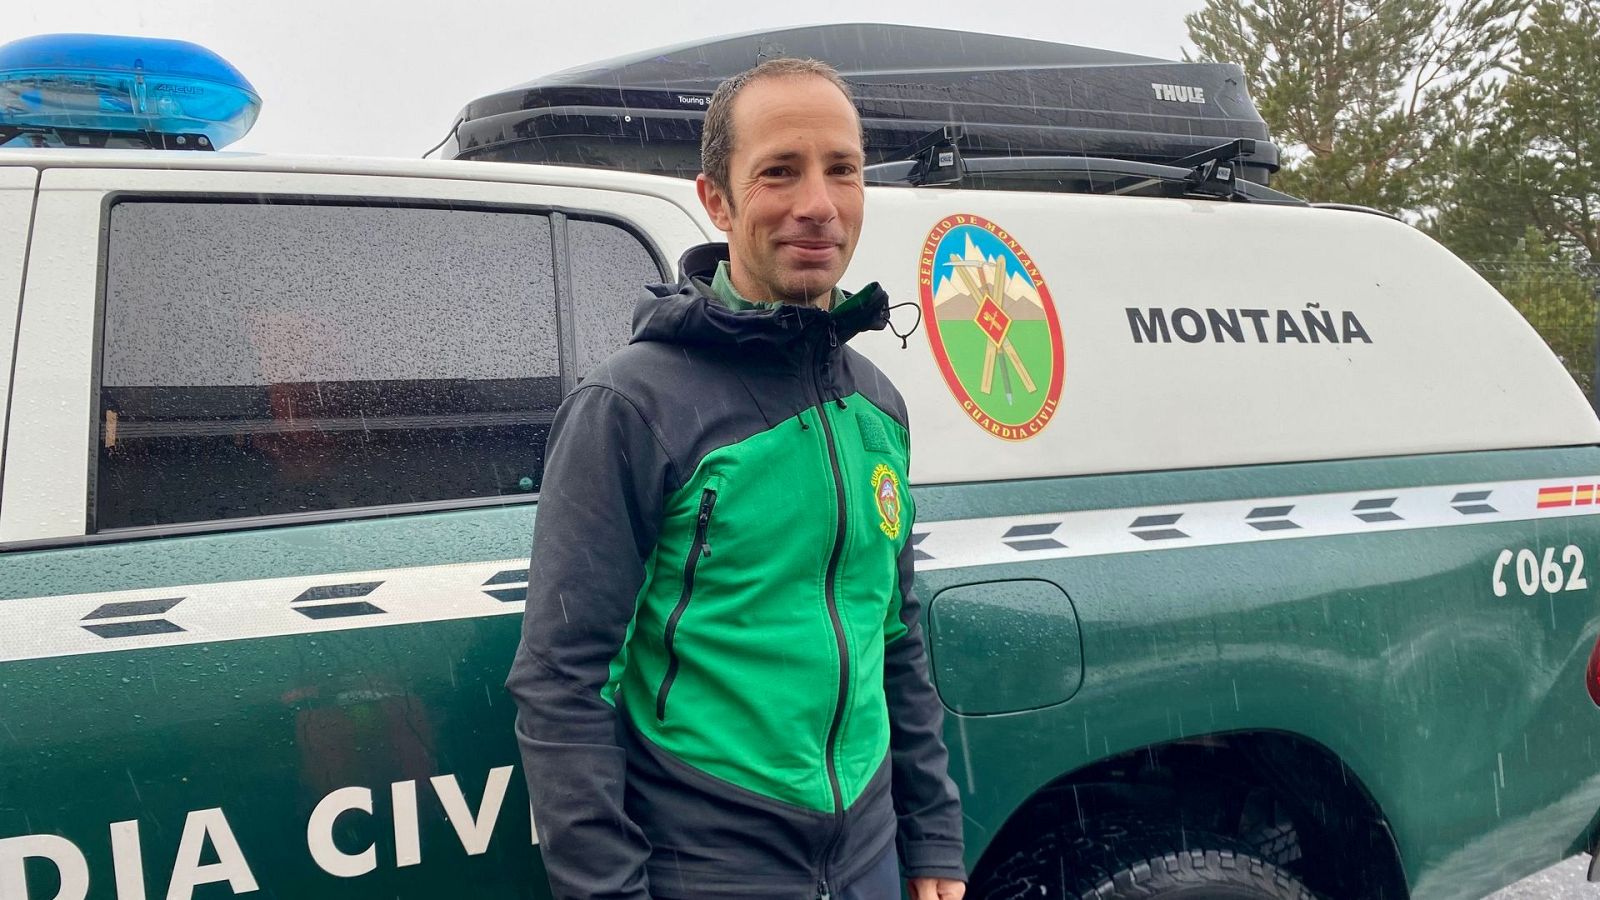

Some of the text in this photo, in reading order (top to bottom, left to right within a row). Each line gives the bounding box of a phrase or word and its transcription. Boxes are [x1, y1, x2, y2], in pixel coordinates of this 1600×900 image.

[678, 96, 704, 105] Touring
[1151, 83, 1206, 104] THULE
[921, 220, 952, 286] SERVICIO
[955, 216, 977, 225] DE
[1125, 302, 1374, 344] MONTAÑA
[963, 399, 1057, 439] GUARDIA CIVIL
[1516, 544, 1588, 596] 062
[306, 764, 541, 878] CIV
